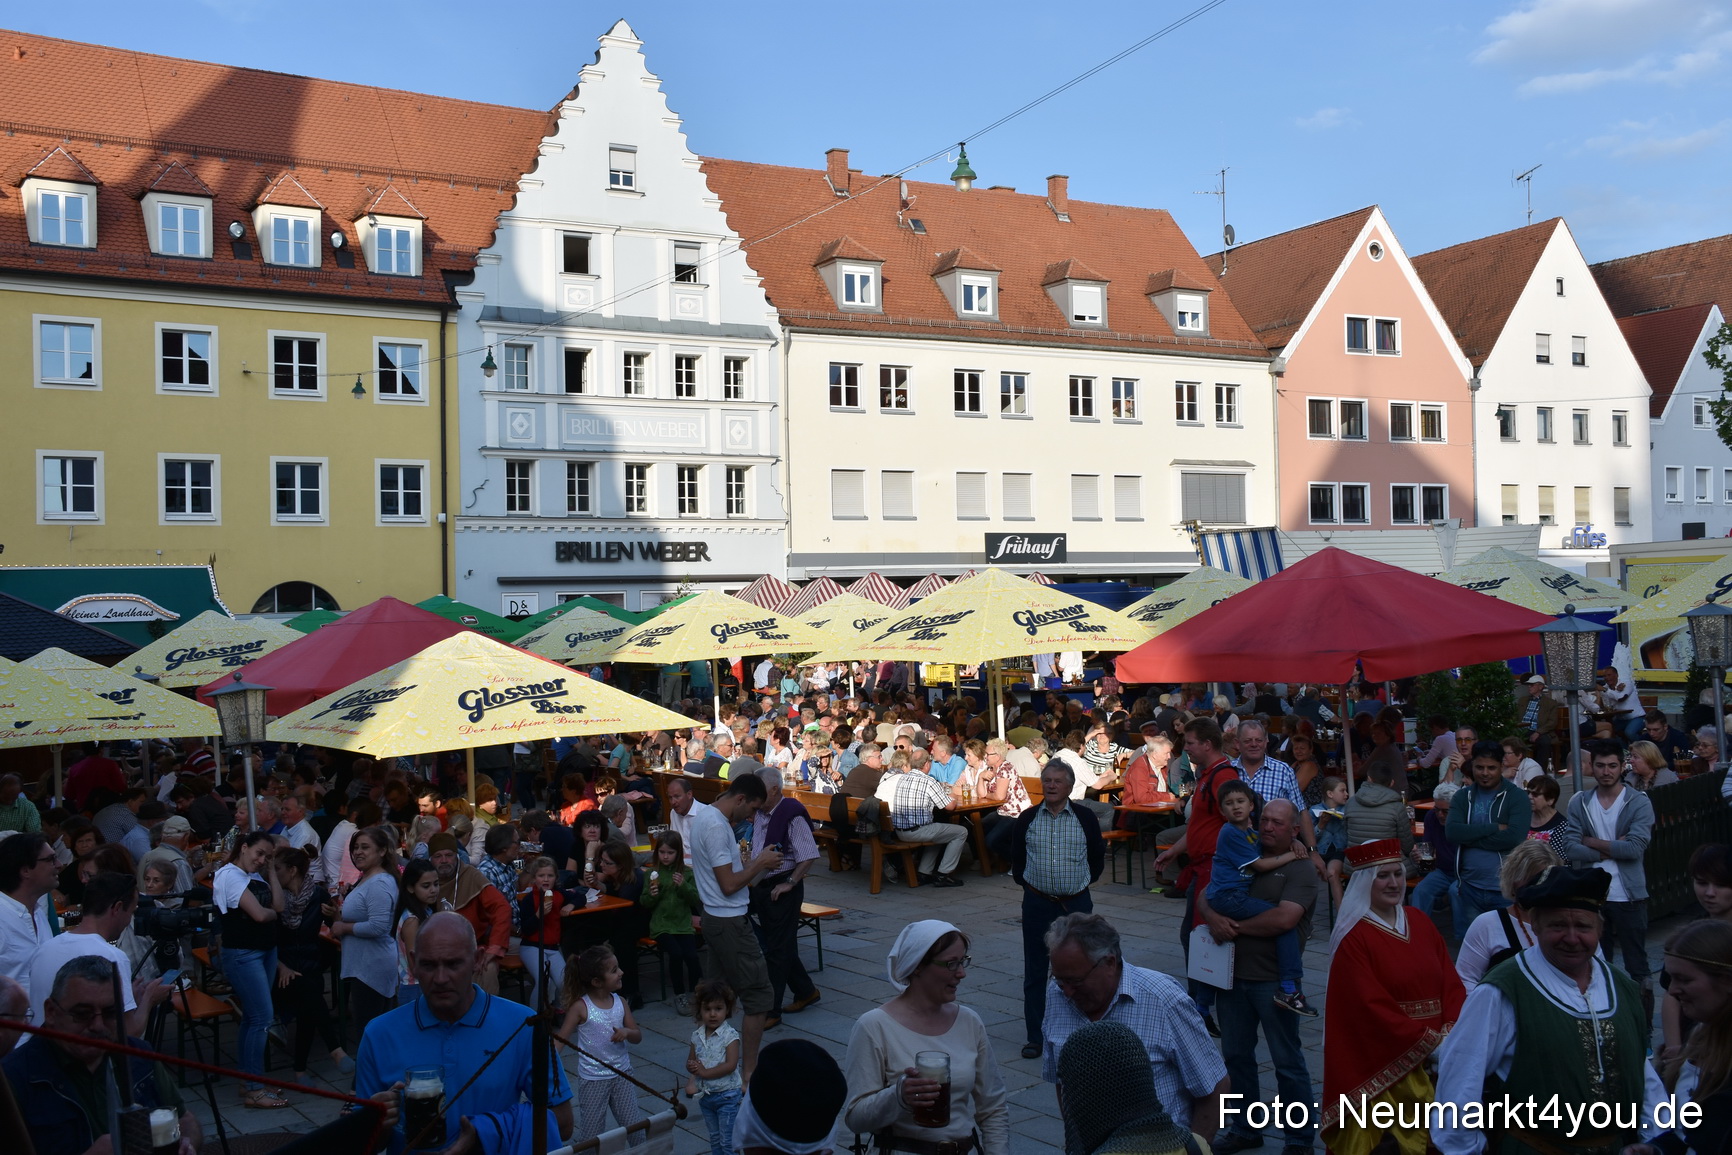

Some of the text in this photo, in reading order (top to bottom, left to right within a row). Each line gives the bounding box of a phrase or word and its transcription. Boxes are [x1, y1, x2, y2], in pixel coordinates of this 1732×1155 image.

[571, 418, 698, 439] BRILLEN WEBER
[555, 541, 712, 562] BRILLEN WEBER
[989, 535, 1064, 559] frühauf
[102, 607, 154, 619] Landhaus
[1012, 604, 1091, 636] Glossner
[710, 617, 779, 644] Glossner
[755, 630, 791, 640] Bier
[1068, 620, 1108, 633] Bier
[565, 627, 626, 648] Glossner
[165, 640, 268, 671] Glossner
[458, 678, 569, 723] Glossner
[530, 699, 587, 714] Bier
[0, 730, 28, 739] Der
[32, 723, 95, 736] hochfeine
[101, 722, 176, 732] Biergenuss
[458, 715, 622, 735] Der hochfeine Biergenuss
